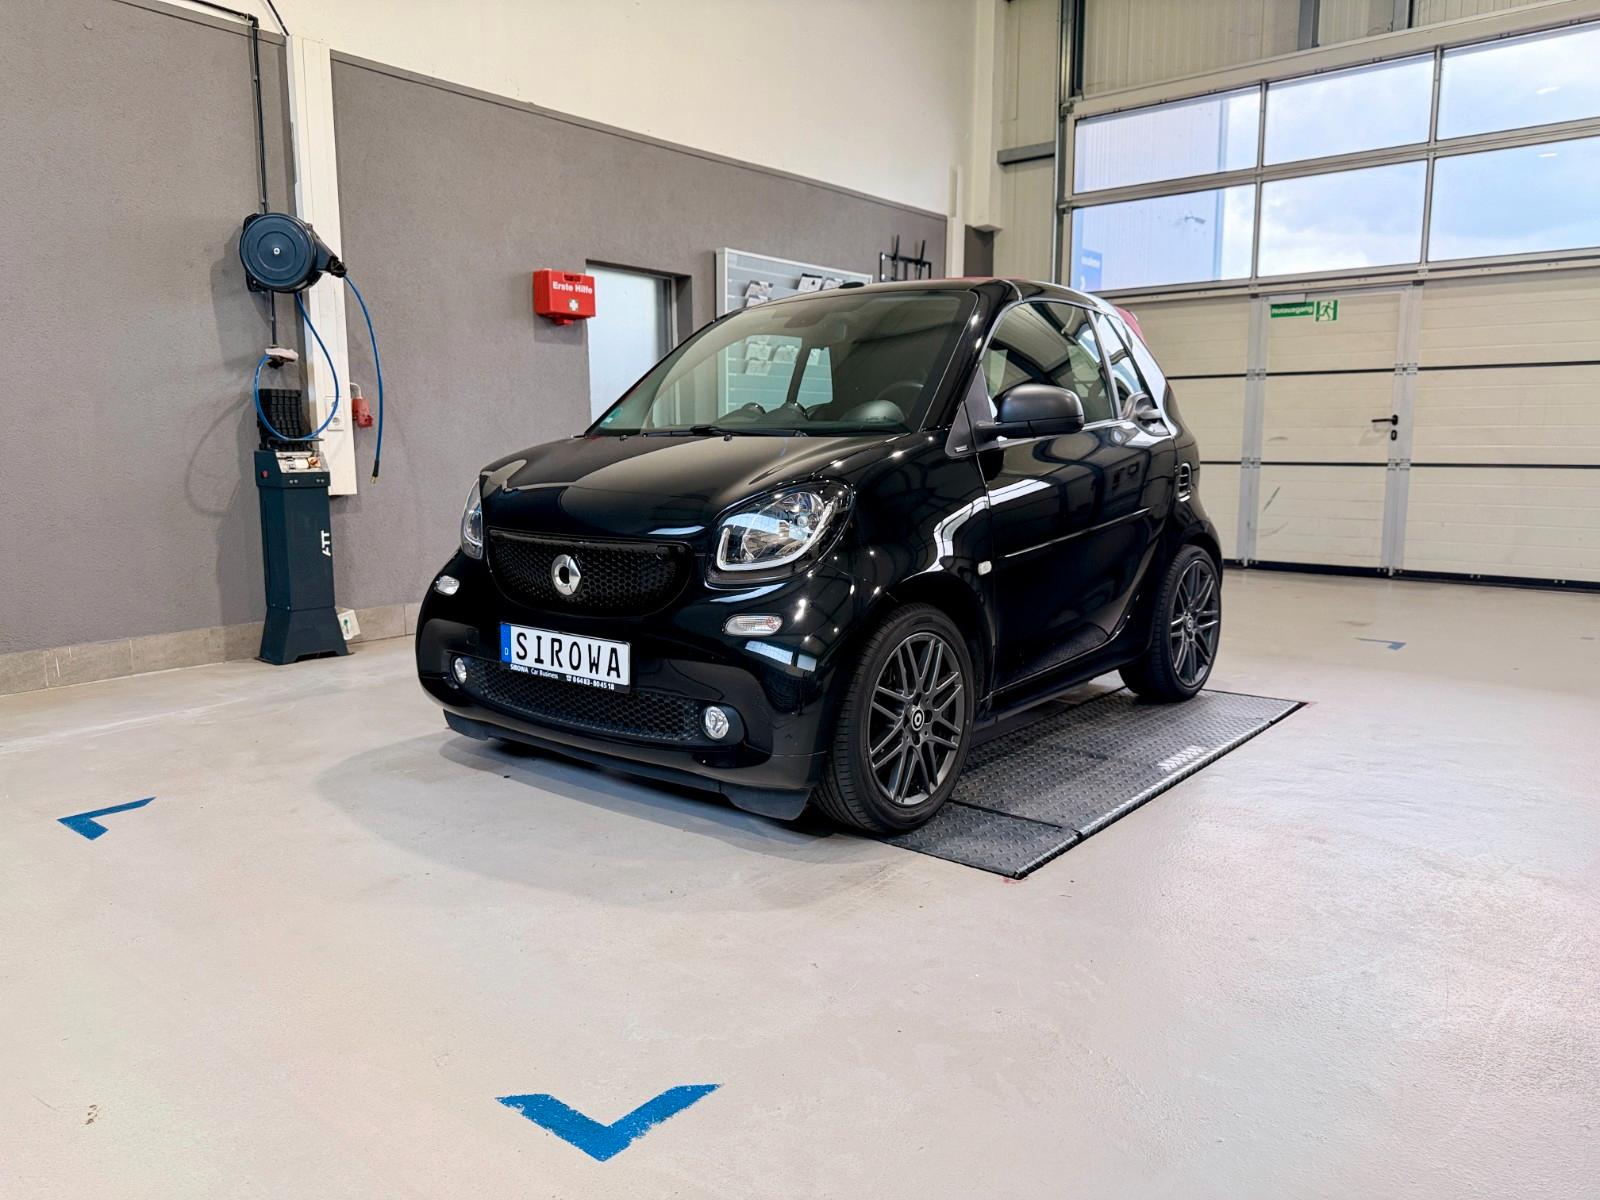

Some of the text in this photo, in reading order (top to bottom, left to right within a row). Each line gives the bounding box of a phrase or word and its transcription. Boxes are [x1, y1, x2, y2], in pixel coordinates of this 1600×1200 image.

[552, 281, 593, 295] Erste Hilfe
[516, 632, 621, 679] SIROWA
